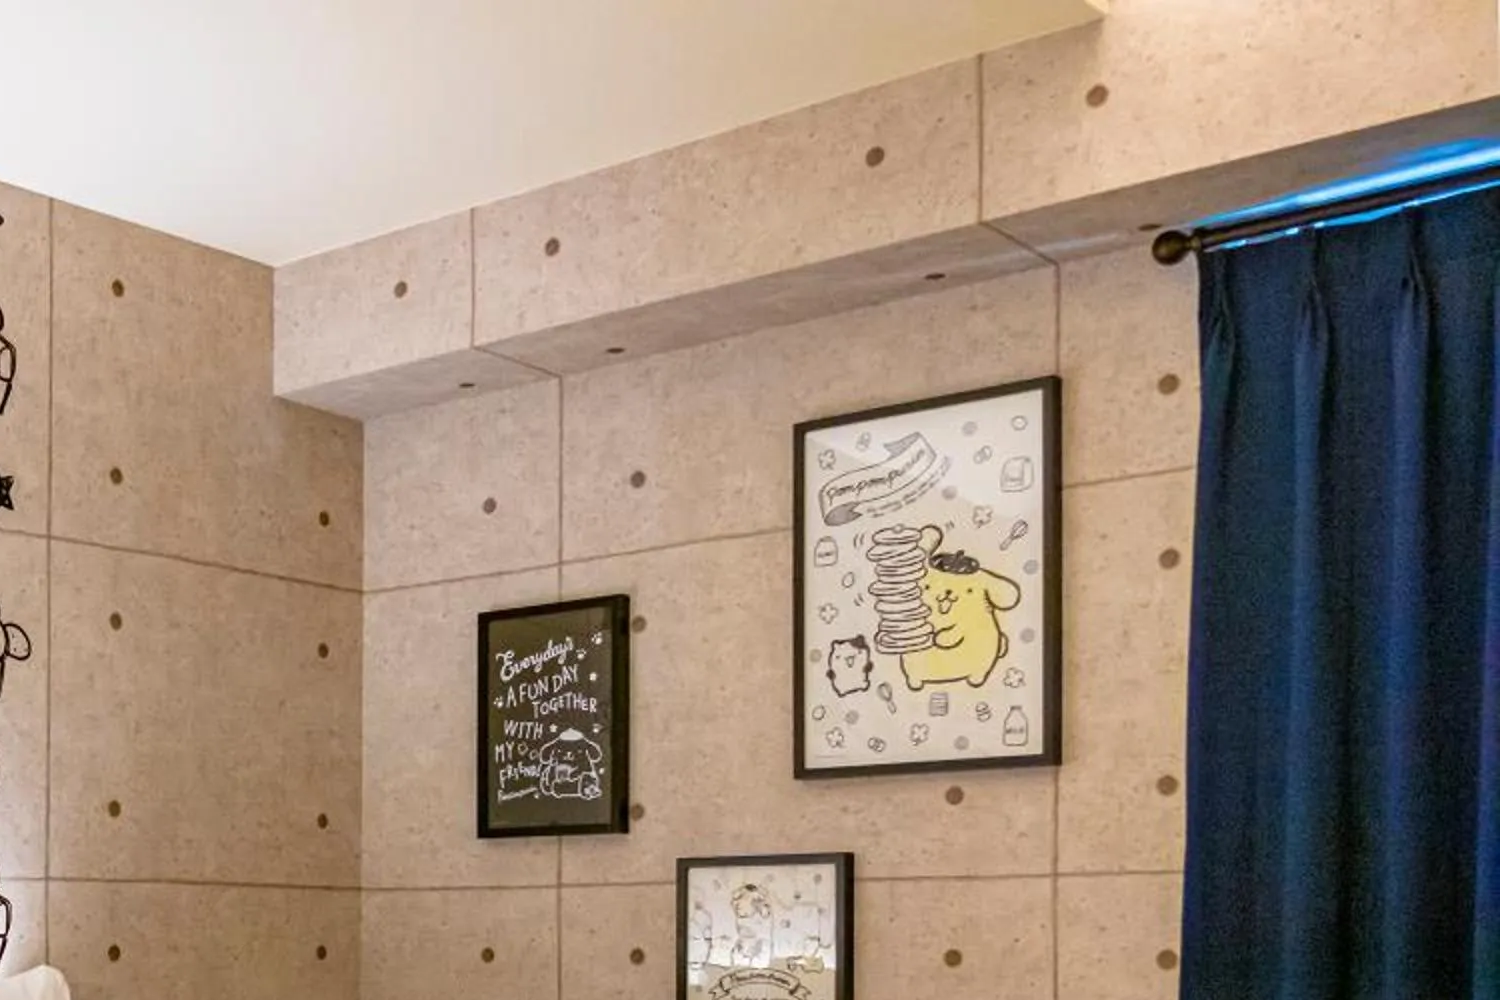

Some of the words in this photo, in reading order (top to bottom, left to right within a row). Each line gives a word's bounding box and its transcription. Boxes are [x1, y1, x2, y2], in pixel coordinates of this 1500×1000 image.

[506, 685, 517, 708] A
[519, 676, 549, 703] FUN
[552, 664, 578, 693] DAY
[531, 691, 597, 719] TOGETHER
[504, 719, 543, 740] WITH
[495, 741, 514, 764] MY
